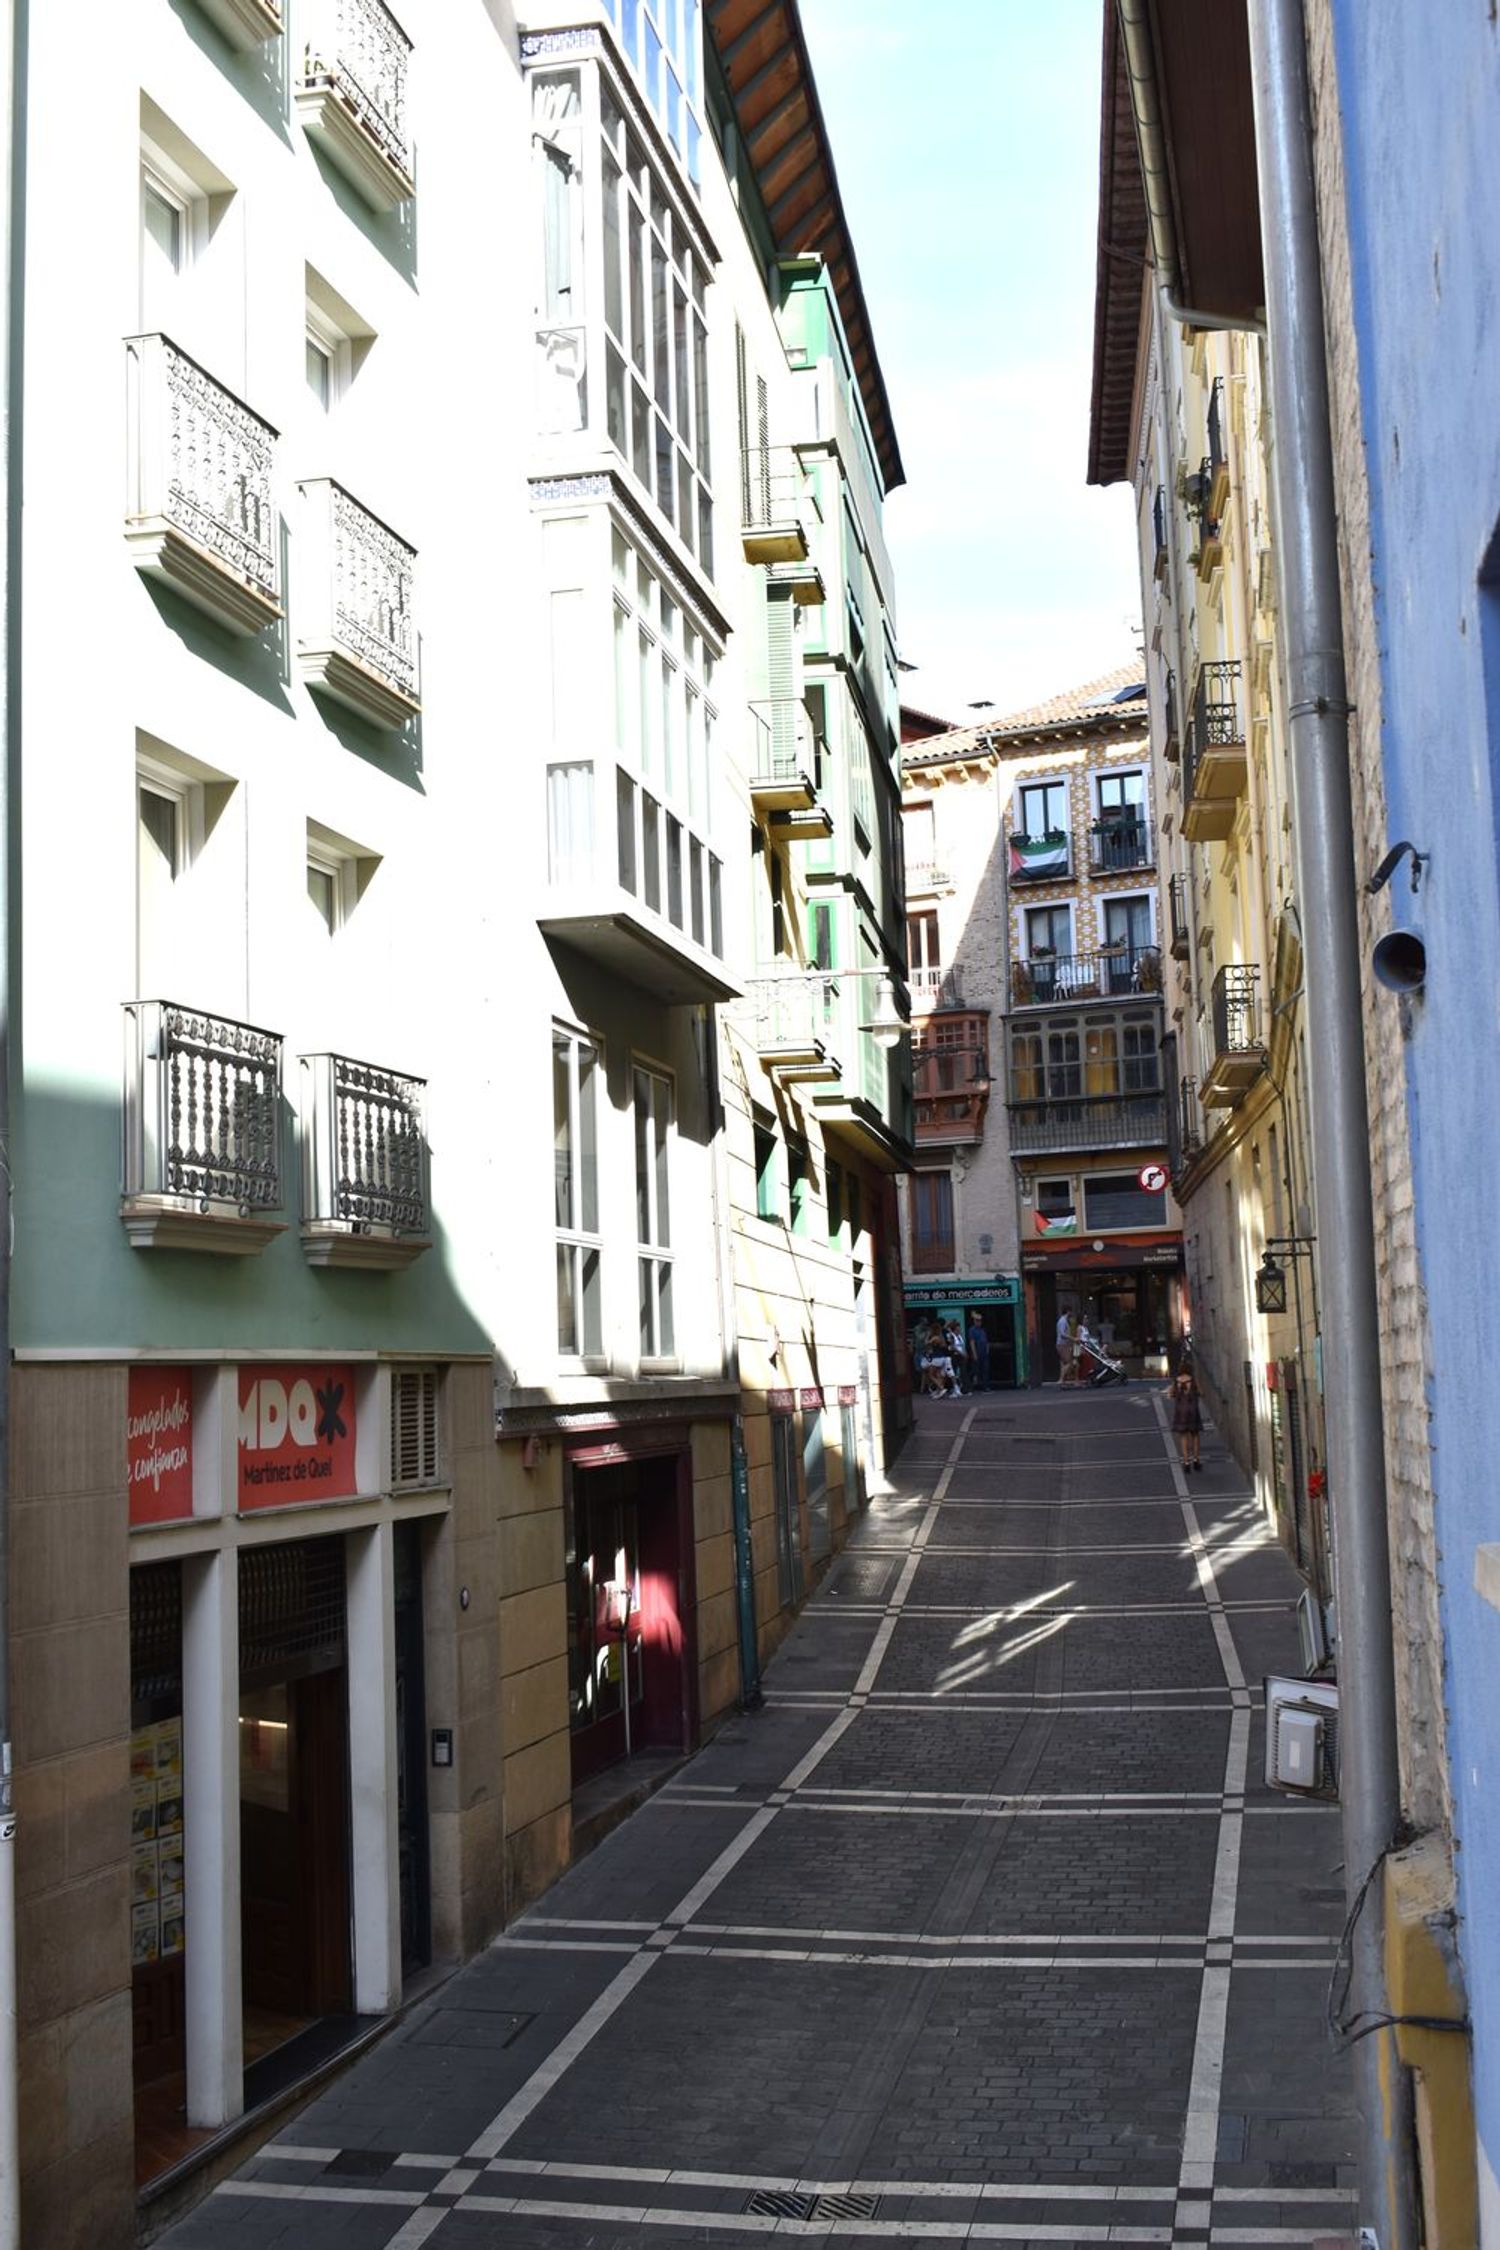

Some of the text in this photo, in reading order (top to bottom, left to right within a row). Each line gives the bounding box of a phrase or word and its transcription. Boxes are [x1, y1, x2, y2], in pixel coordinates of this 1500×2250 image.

[128, 1386, 189, 1450] congelados
[238, 1378, 317, 1450] MDQ
[135, 1446, 187, 1493] confianza
[293, 1460, 306, 1480] de
